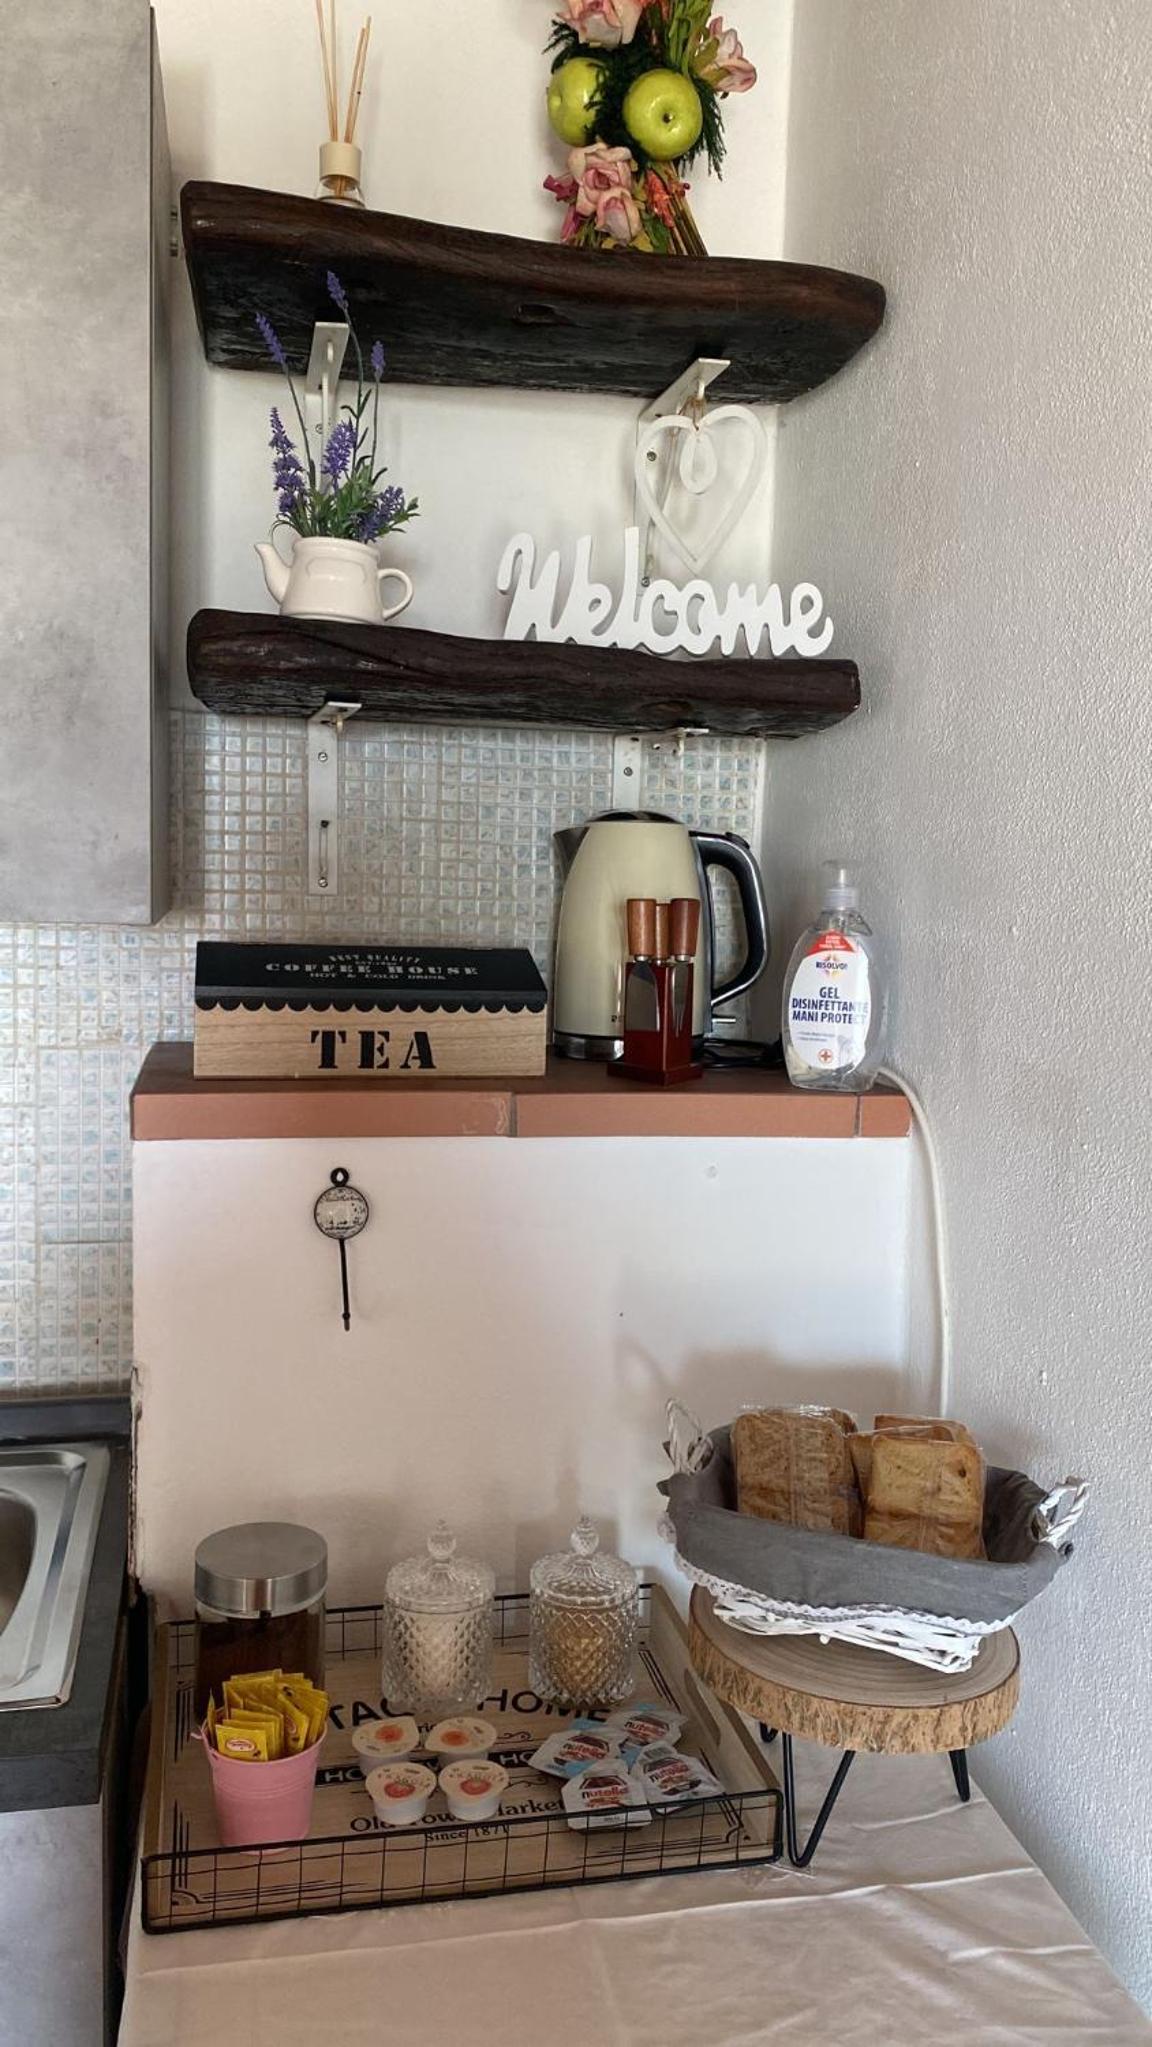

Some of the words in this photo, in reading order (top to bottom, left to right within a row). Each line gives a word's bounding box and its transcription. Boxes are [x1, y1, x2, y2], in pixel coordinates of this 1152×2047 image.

[497, 527, 834, 657] Welcome
[265, 963, 370, 973] COFFEE
[387, 966, 479, 975] HOUSE
[819, 986, 840, 999] GEL
[792, 997, 869, 1013] DISINFETTANTE
[792, 1010, 818, 1022] MANI
[310, 1030, 436, 1069] TEA
[582, 1786, 629, 1799] nutella
